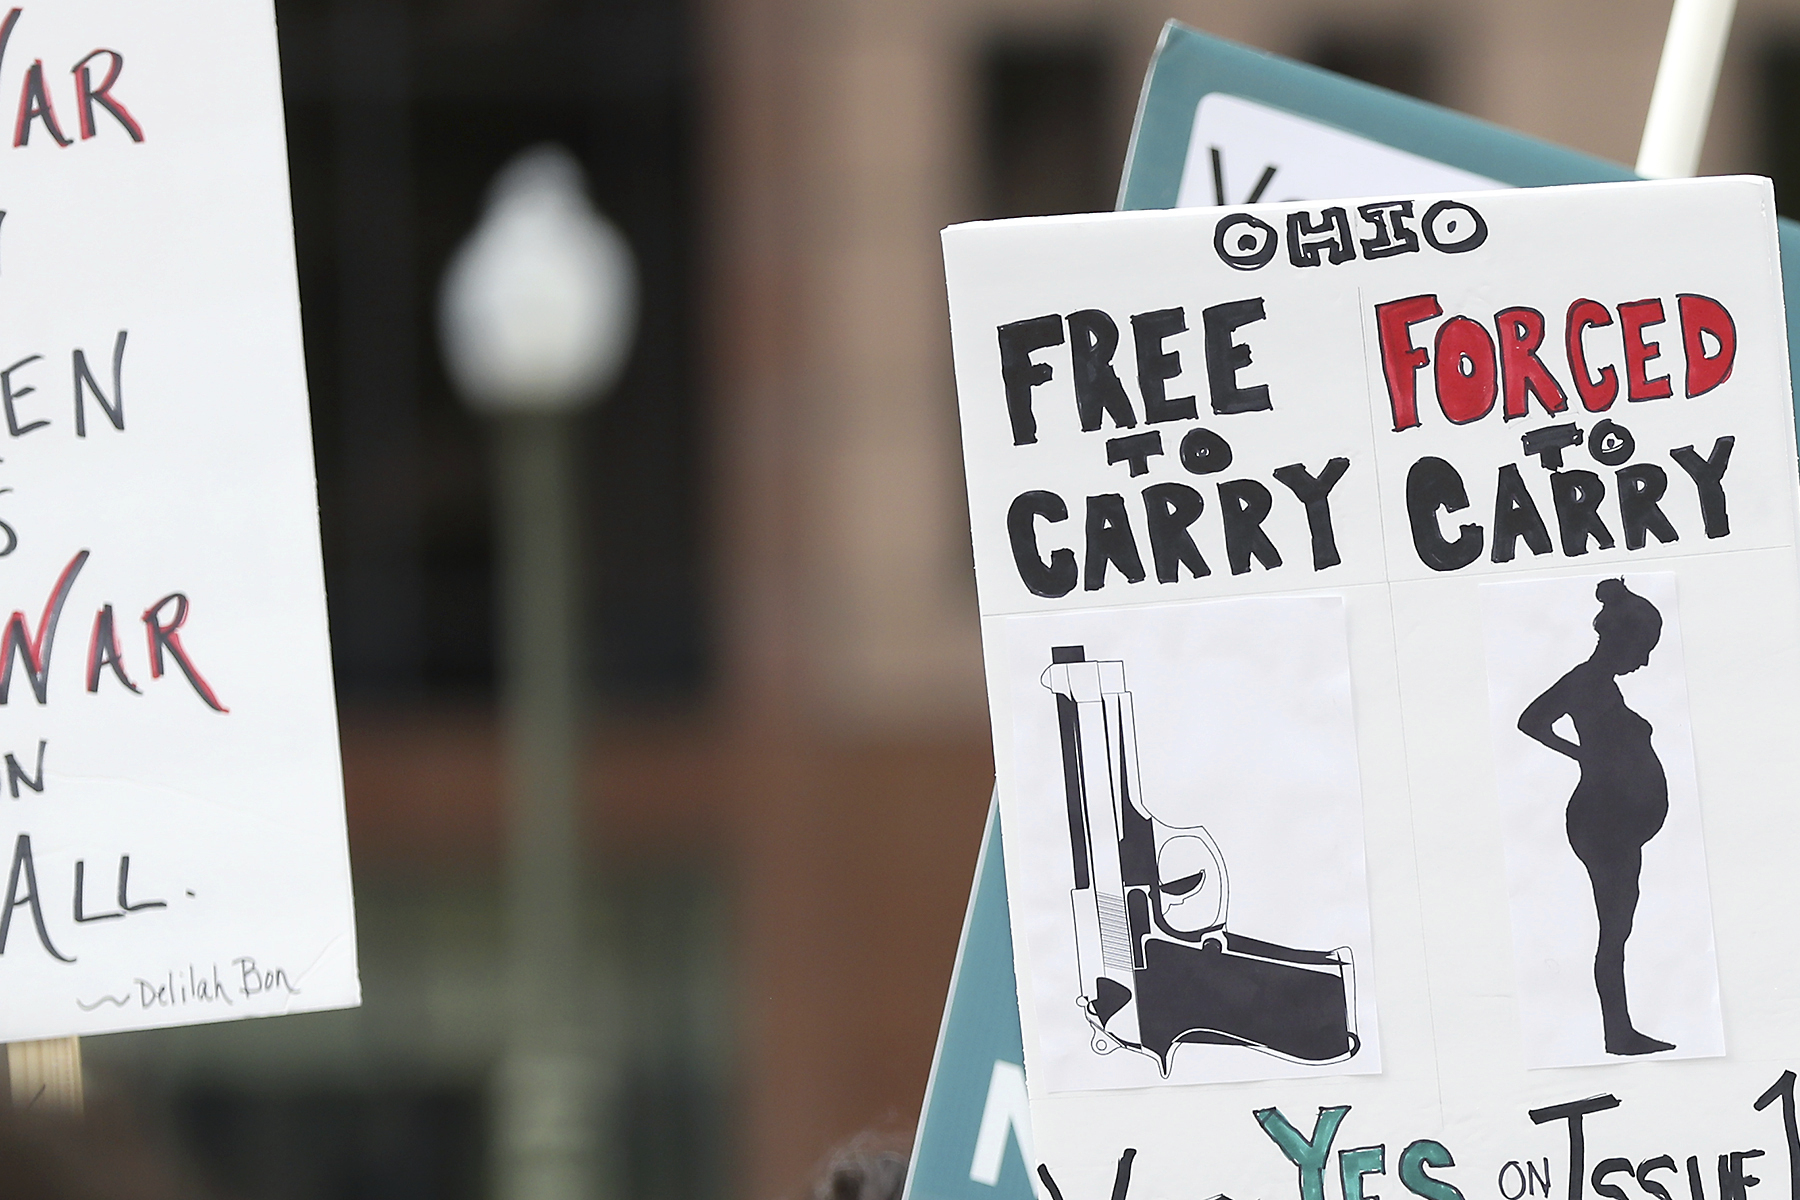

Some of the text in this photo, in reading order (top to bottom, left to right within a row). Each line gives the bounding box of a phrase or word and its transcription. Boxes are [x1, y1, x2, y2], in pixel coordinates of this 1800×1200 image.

[0, 7, 145, 148] AR
[1213, 200, 1488, 271] OHIO
[997, 297, 1272, 446] FREE
[1375, 294, 1737, 432] FORCED
[1107, 427, 1233, 476] TO
[1406, 435, 1735, 571] CARRY
[1522, 421, 1636, 470] TO
[1006, 457, 1350, 597] CARRY
